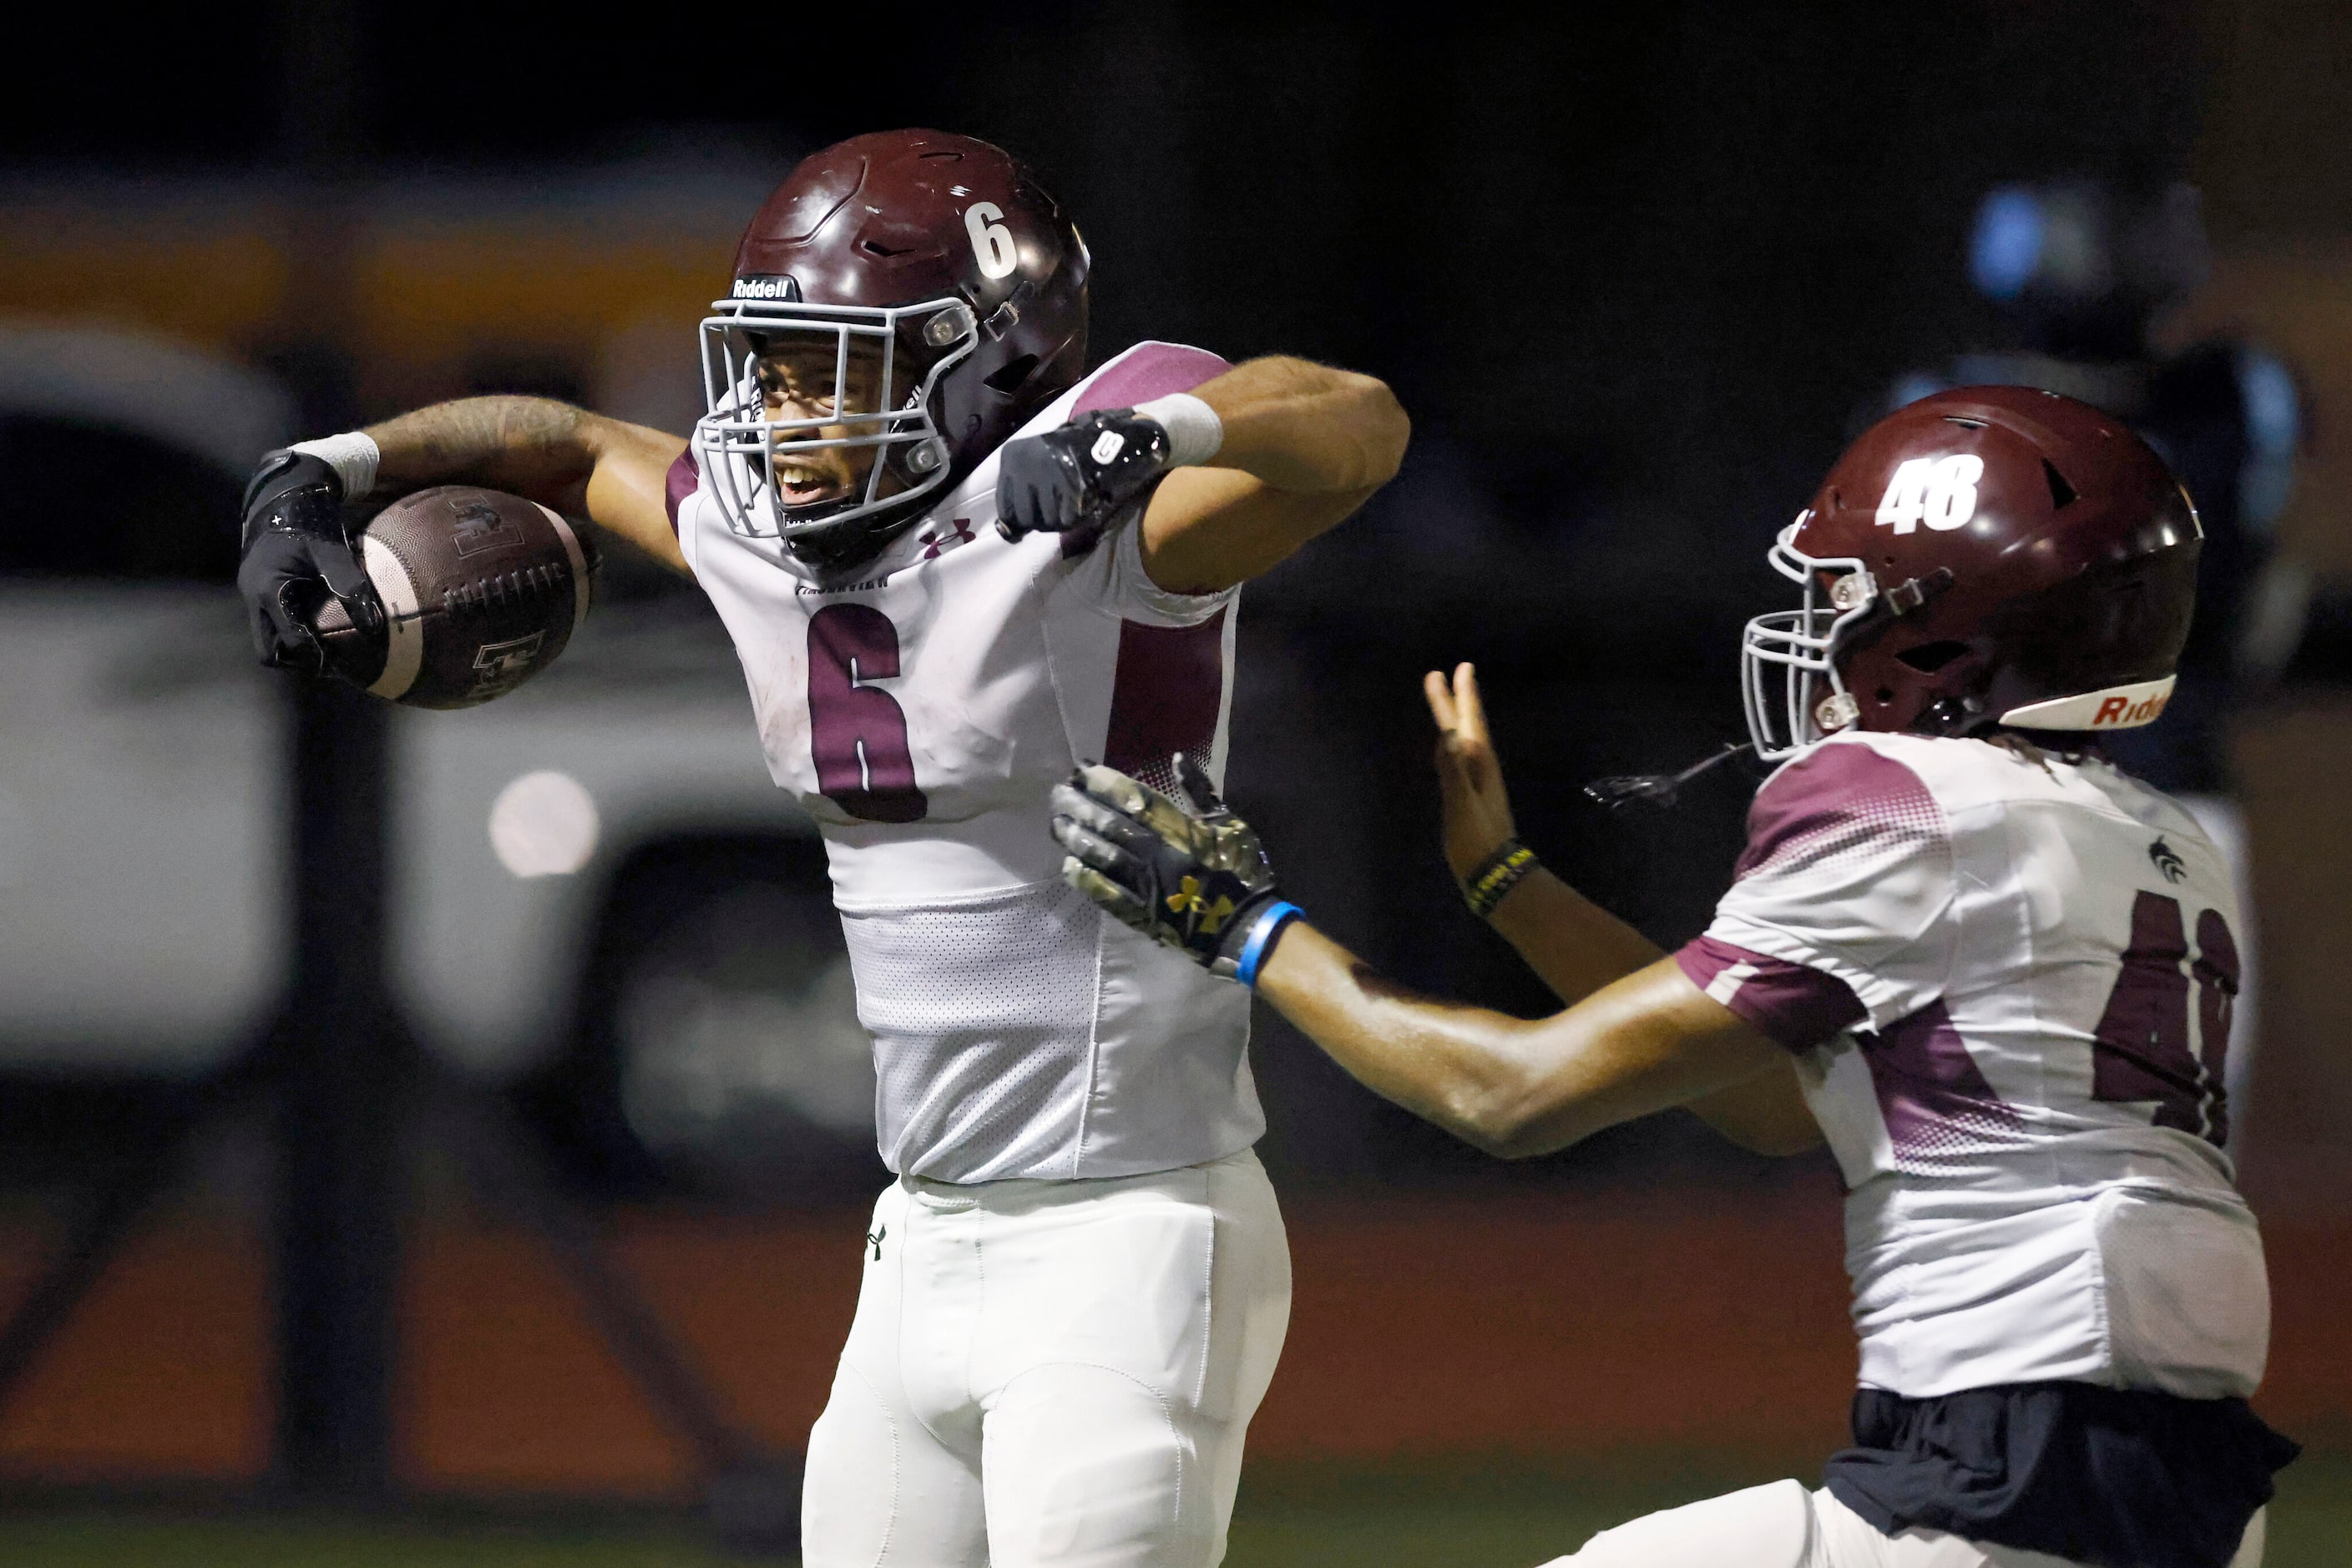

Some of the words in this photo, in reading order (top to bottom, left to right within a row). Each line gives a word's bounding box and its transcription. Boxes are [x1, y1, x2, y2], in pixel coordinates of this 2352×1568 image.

[964, 201, 1018, 279] 6
[733, 279, 789, 298] Riddell
[1874, 453, 1984, 535] 48
[807, 603, 928, 822] 6
